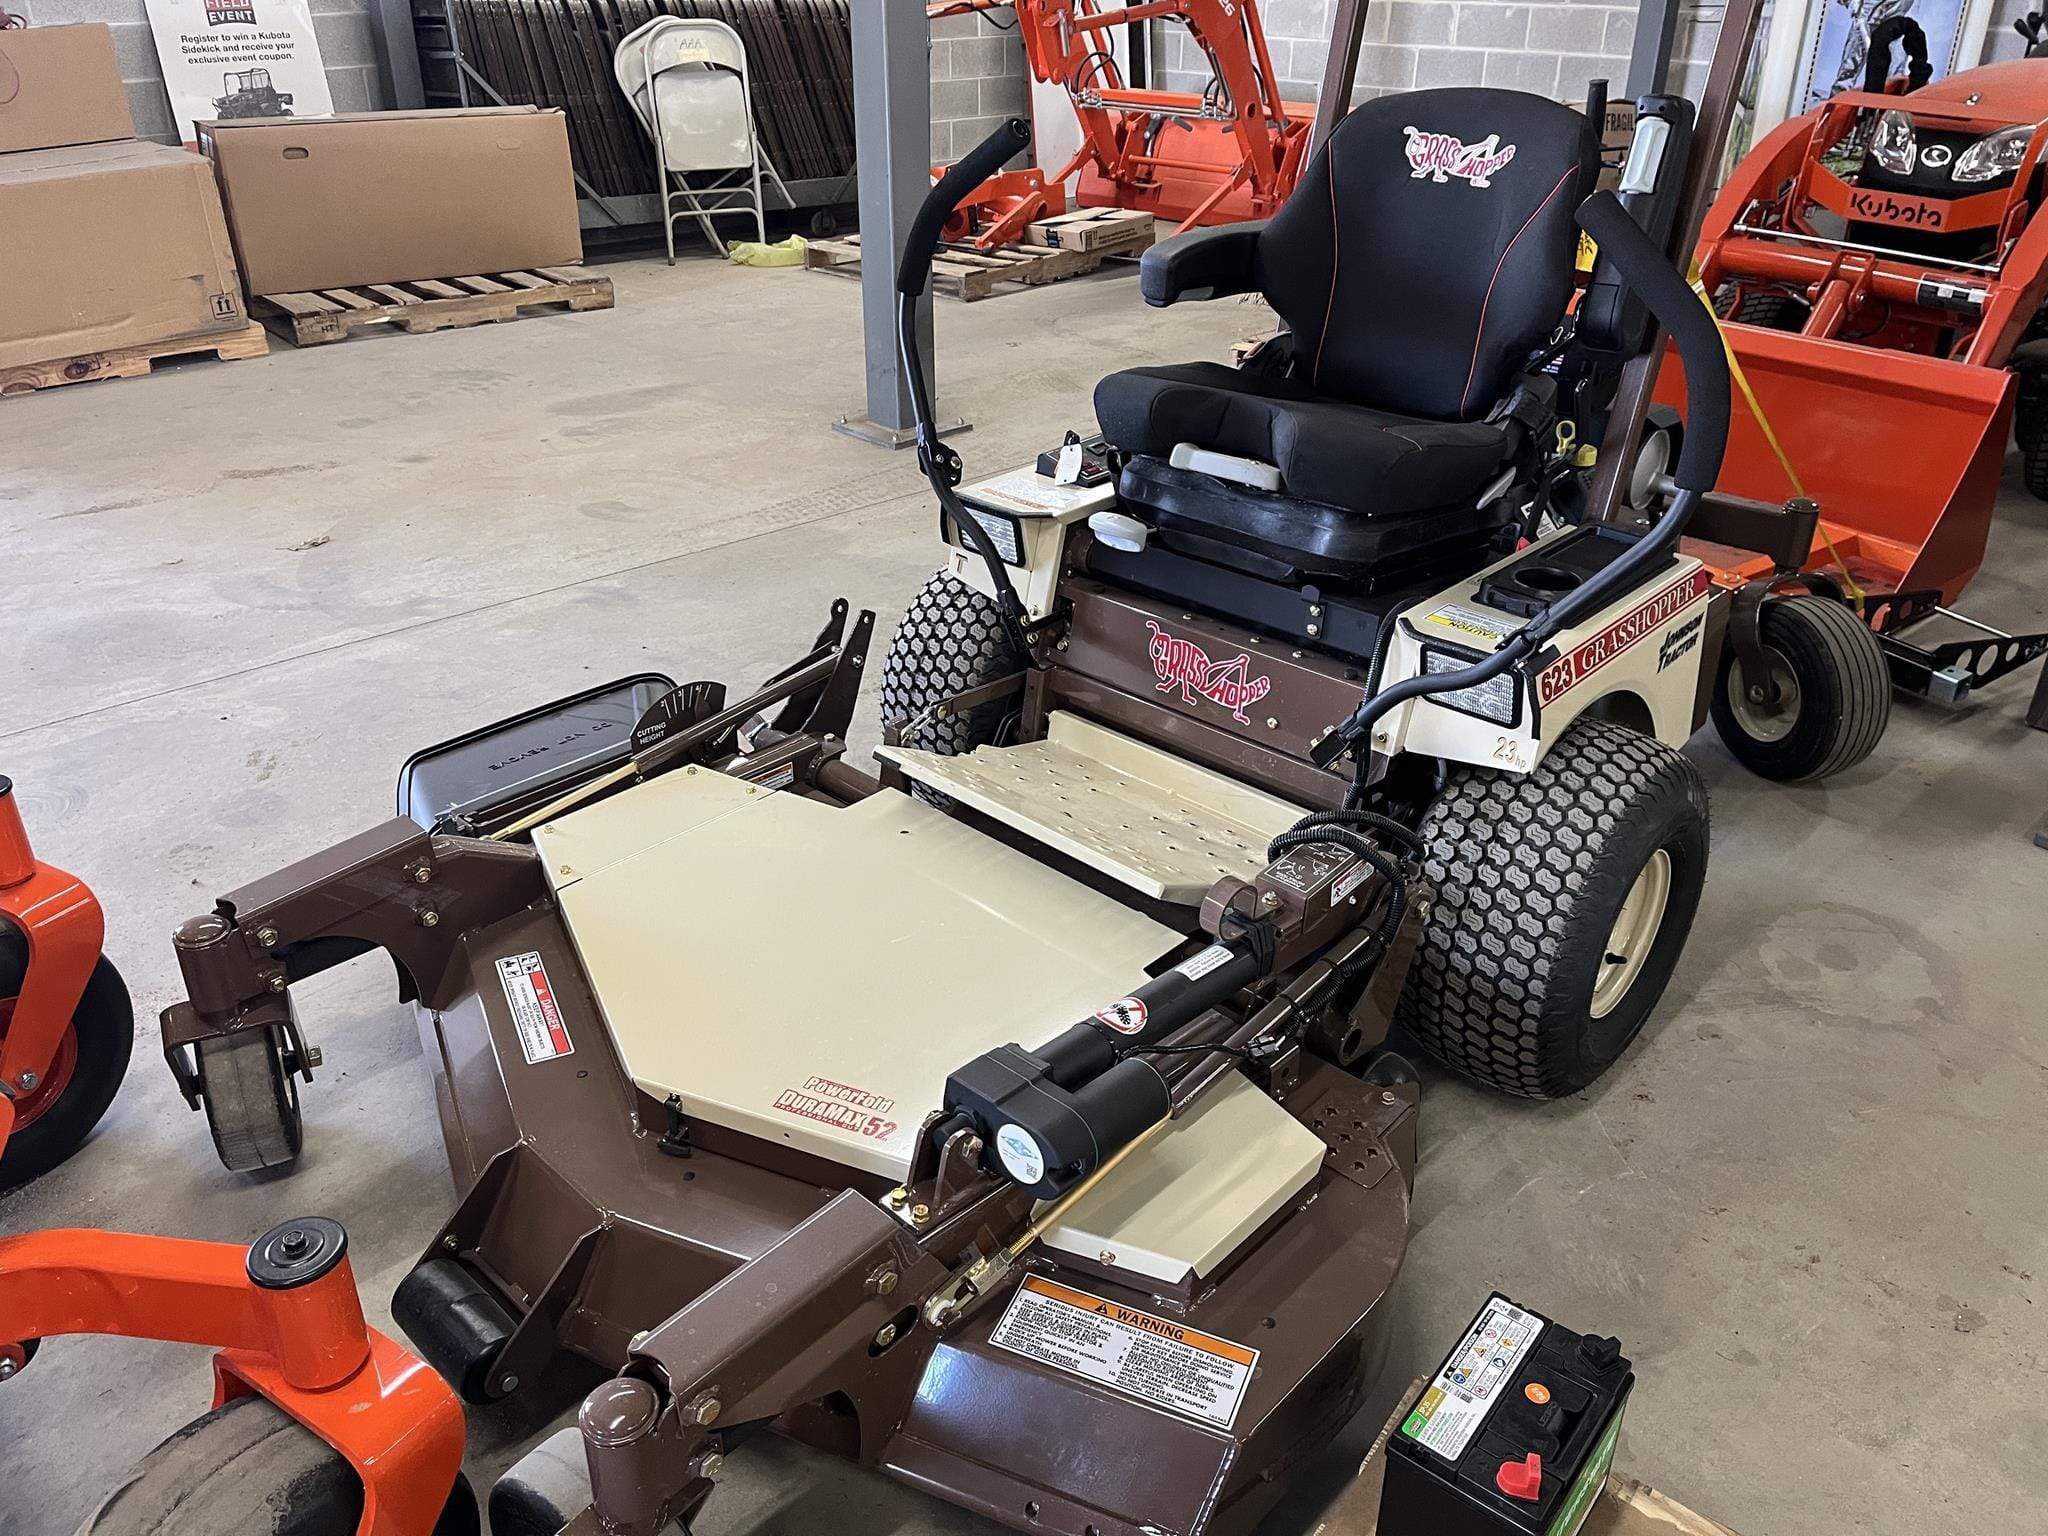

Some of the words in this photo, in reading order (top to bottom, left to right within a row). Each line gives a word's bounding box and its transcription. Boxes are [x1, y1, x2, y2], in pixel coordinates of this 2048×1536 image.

[209, 10, 252, 24] EVENT
[180, 34, 219, 44] Register
[222, 34, 231, 42] to
[232, 33, 250, 41] win
[258, 32, 291, 40] Kubota
[182, 44, 222, 54] Sidekick
[222, 43, 240, 52] and
[241, 42, 274, 52] receive
[274, 42, 295, 51] your
[188, 54, 230, 65] exclusive
[232, 53, 258, 63] event
[258, 53, 295, 63] coupon.
[1850, 192, 1942, 227] Kubota
[1580, 578, 1696, 671] GRASSHOPPER
[1656, 631, 1699, 674] TRACTOR
[1150, 630, 1270, 712] GRASSHOPPER
[1541, 658, 1573, 701] 623
[636, 722, 667, 738] CUTTING
[640, 730, 665, 745] HEIGHT
[543, 998, 560, 1031] DANGER
[862, 1117, 898, 1140] 52
[1021, 1302, 1043, 1312] FOLLOW
[1054, 1314, 1073, 1323] SAFETY
[1038, 1304, 1070, 1318] OPERATOR'S
[1071, 1315, 1094, 1326] MANUAL
[1117, 1309, 1184, 1340] WARNING
[1012, 1318, 1042, 1331] EQUIPMENT
[1043, 1329, 1066, 1340] QUICKLY
[1014, 1314, 1033, 1323] KNOW
[1072, 1334, 1097, 1346] TRACTOR
[1045, 1299, 1074, 1312] SERIOUS
[1074, 1309, 1098, 1321] INJURY
[1099, 1318, 1114, 1327] CAN
[1115, 1324, 1141, 1336] RESULT
[1142, 1333, 1163, 1344] FROM
[1164, 1341, 1193, 1354] FAILURE
[1205, 1355, 1236, 1369] FOLLOW.
[1008, 1326, 1026, 1335] BLOCK
[1035, 1336, 1056, 1346] MOWER
[1057, 1343, 1077, 1353] BEFORE
[1077, 1351, 1107, 1364] WORKING
[1026, 1342, 1049, 1353] OPERATE
[1050, 1350, 1072, 1361] MOWER
[1033, 1349, 1052, 1359] OTHER
[1140, 1348, 1180, 1365] MAINTENANCE
[1149, 1342, 1170, 1352] ENGINE
[1171, 1350, 1191, 1360] BEFORE
[1125, 1358, 1141, 1366] CLEAR
[1142, 1364, 1168, 1376] MOWING
[1169, 1373, 1185, 1382] AREA
[1128, 1350, 1148, 1359] ALLOW
[1197, 1374, 1234, 1390] UNQUALIFIED
[1132, 1341, 1155, 1352] REMOVE
[1168, 1353, 1188, 1363] BEFORE
[1188, 1361, 1209, 1370] DOING
[1210, 1368, 1231, 1378] SERVICE
[1119, 1370, 1137, 1379] WHEN
[1121, 1366, 1144, 1377] UNEVEN
[1170, 1384, 1198, 1396] DECREASE
[1198, 1394, 1216, 1403] SPEED
[1131, 1364, 1154, 1376] CAREFUL
[1155, 1373, 1173, 1382] WHEN
[1173, 1380, 1206, 1394] OPERATING
[1140, 1382, 1165, 1395] OPERATE
[1173, 1394, 1207, 1410] TRANSPORT
